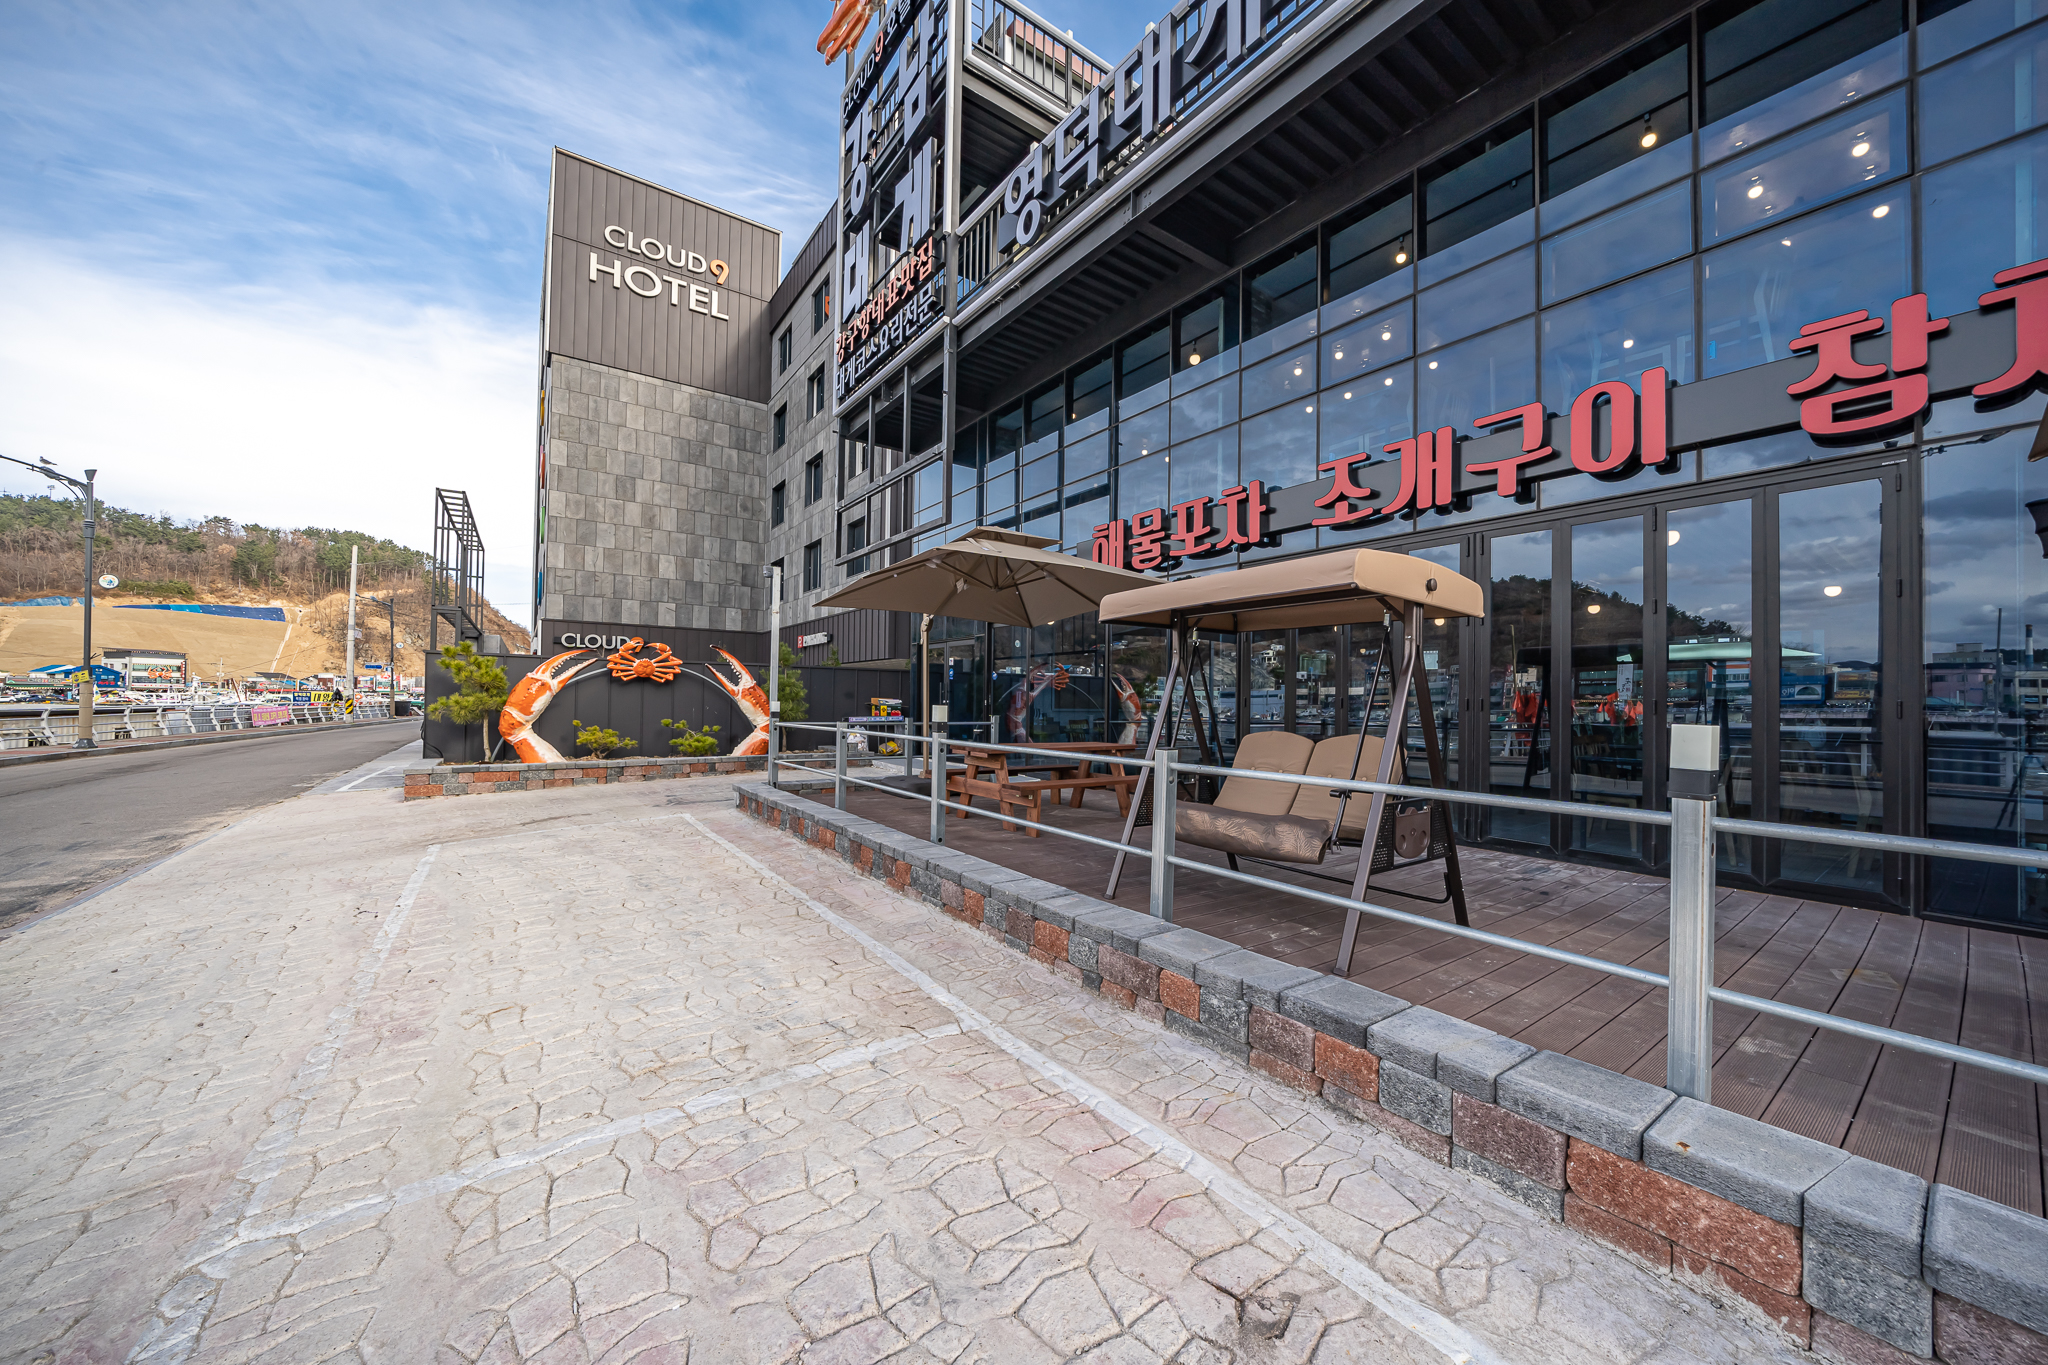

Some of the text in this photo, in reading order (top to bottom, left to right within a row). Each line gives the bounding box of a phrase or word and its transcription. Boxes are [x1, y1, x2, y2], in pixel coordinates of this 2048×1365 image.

[843, 31, 884, 120] CLOUD9
[588, 251, 730, 321] HOTEL
[603, 224, 730, 286] CLOUD9
[1091, 479, 1268, 571] 해물포차
[1310, 365, 1668, 527] 조개구이
